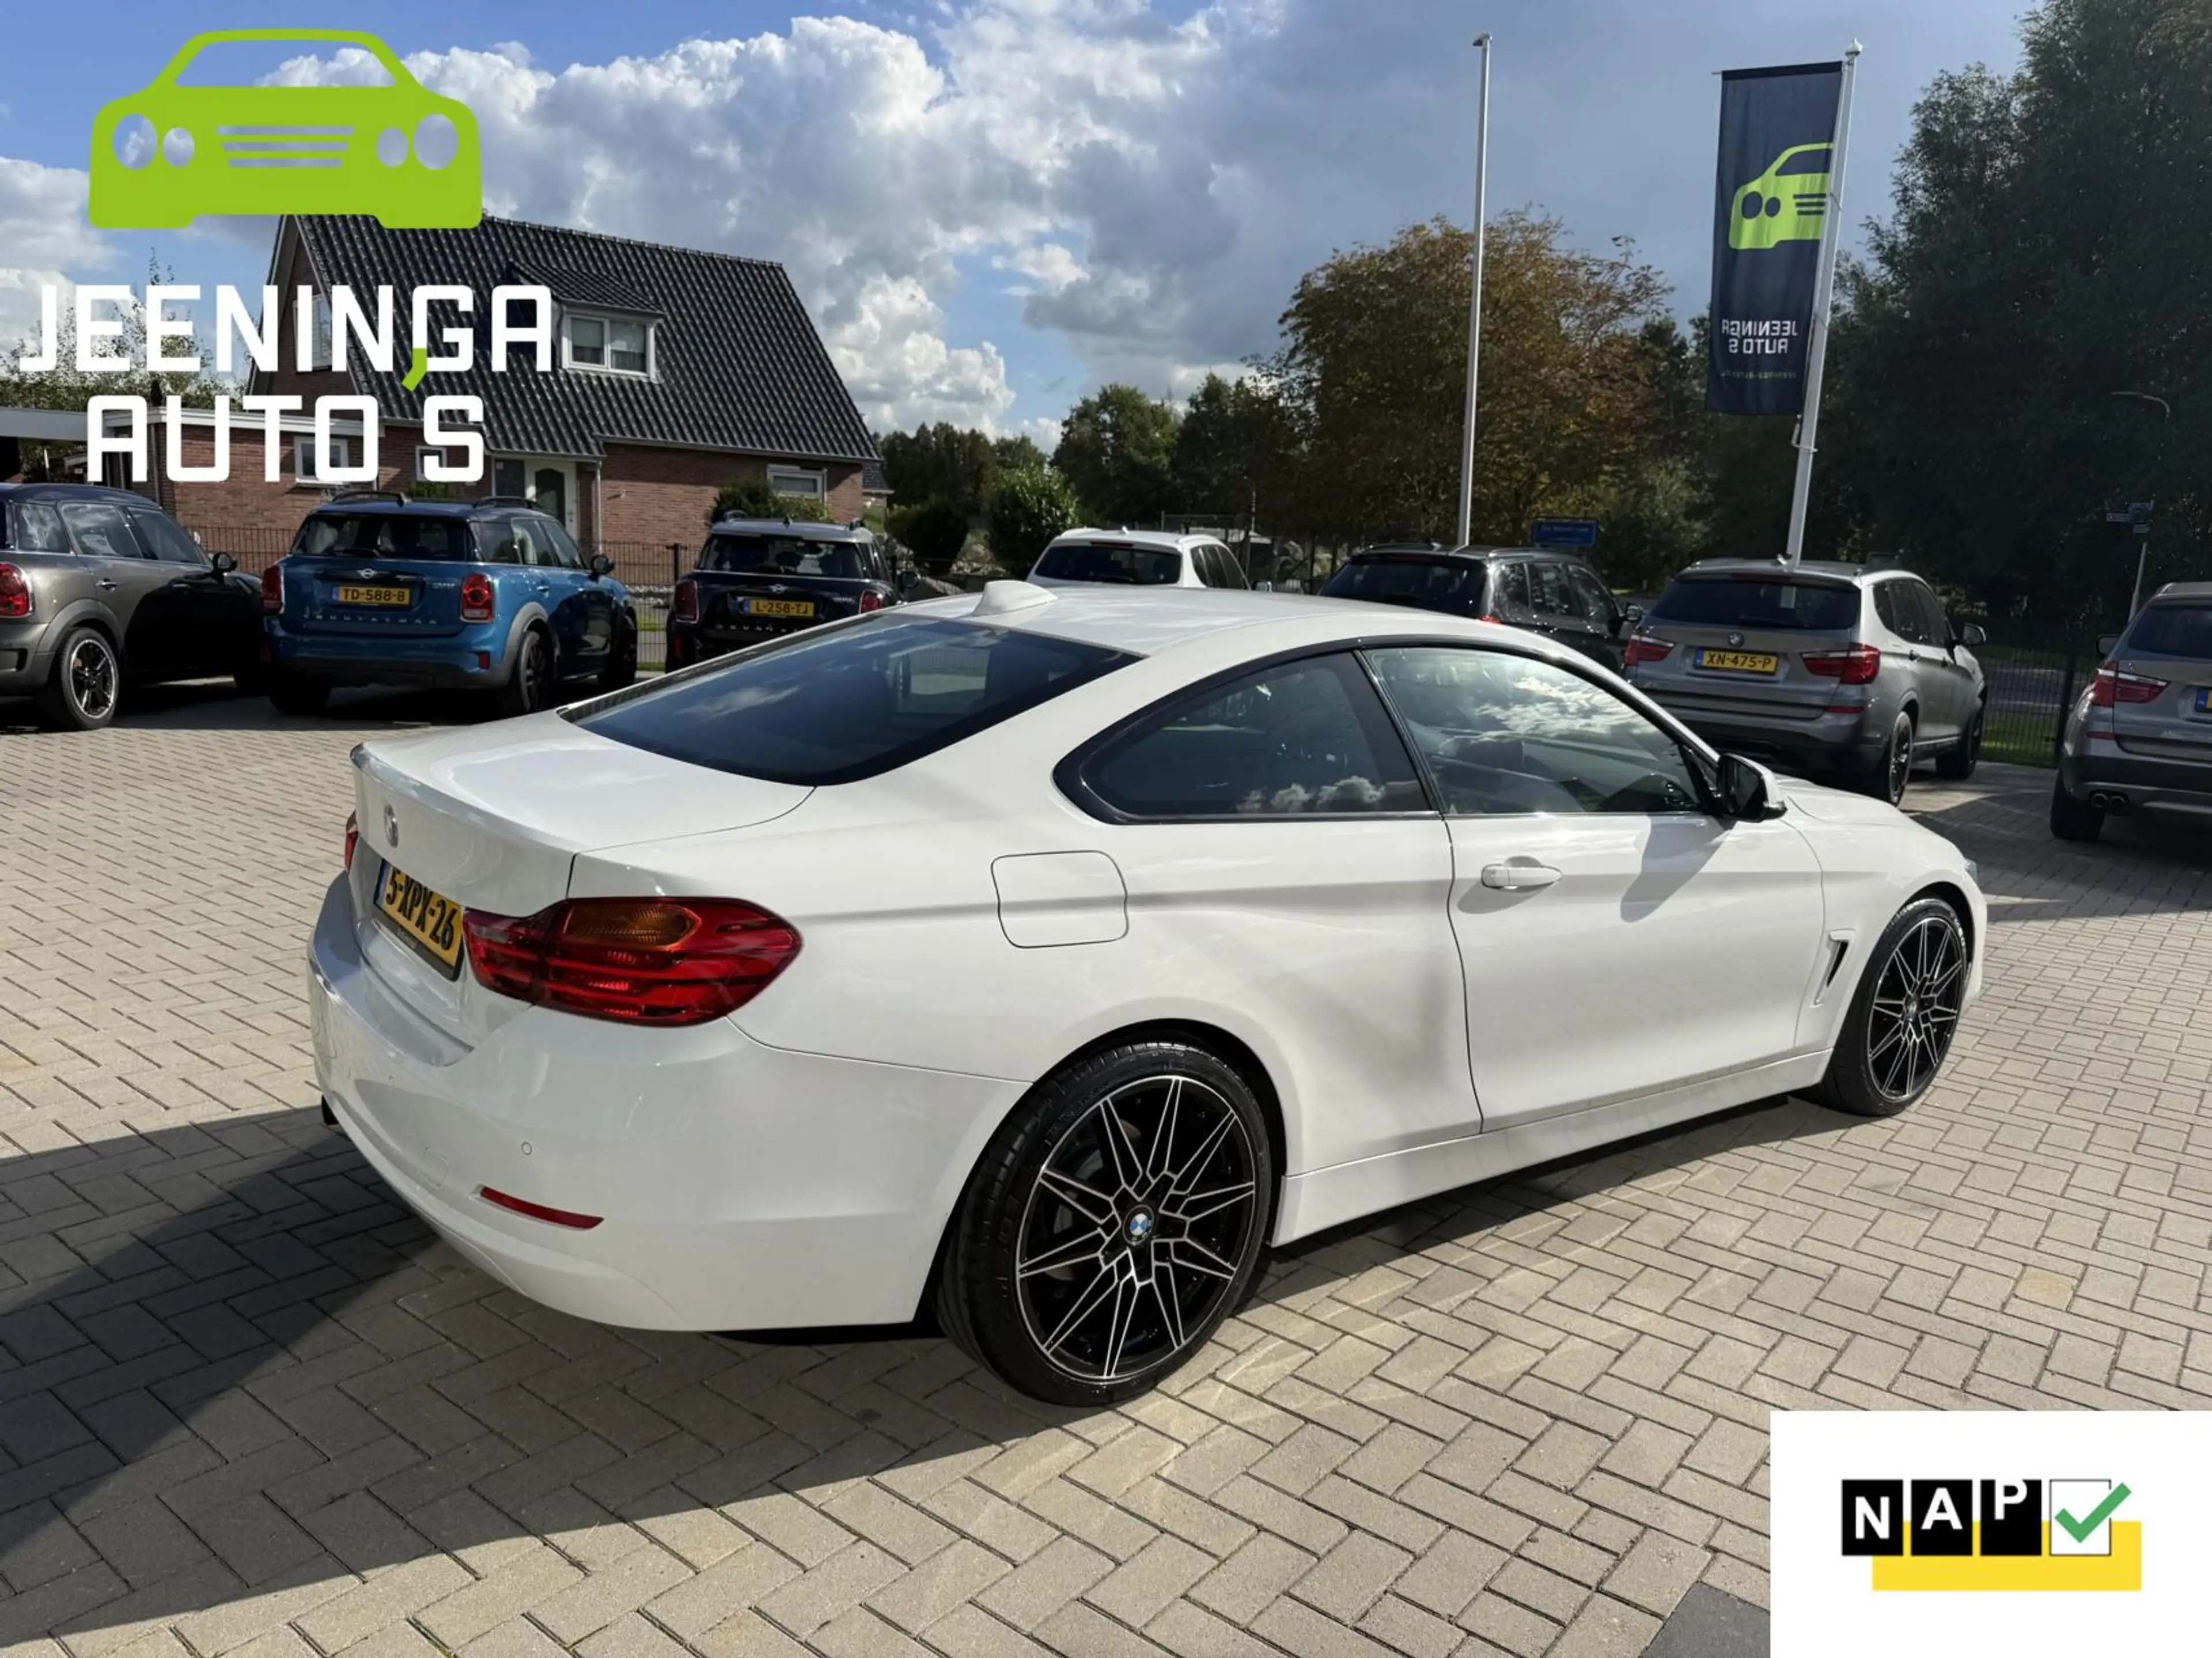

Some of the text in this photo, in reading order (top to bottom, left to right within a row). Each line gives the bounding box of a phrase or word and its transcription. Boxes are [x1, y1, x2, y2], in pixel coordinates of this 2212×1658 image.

[342, 588, 406, 602] TD-588-B
[755, 601, 809, 614] L-258-TJ
[1706, 652, 1772, 669] XN-475-P
